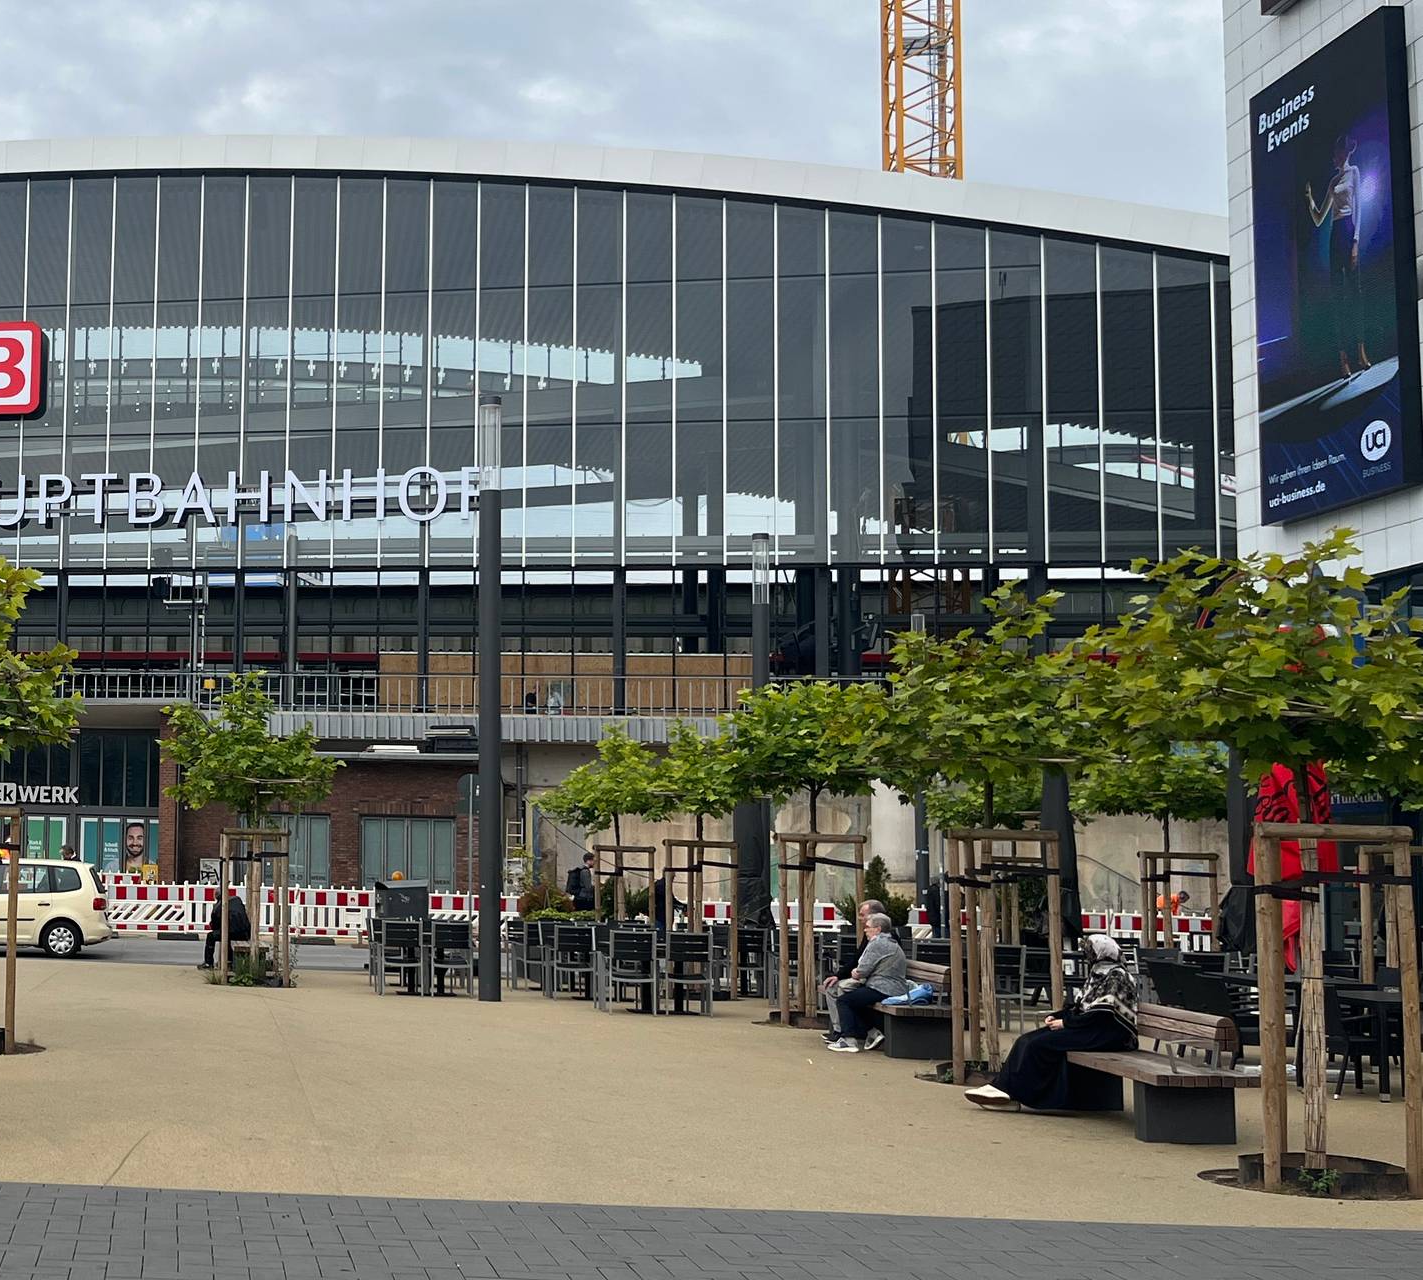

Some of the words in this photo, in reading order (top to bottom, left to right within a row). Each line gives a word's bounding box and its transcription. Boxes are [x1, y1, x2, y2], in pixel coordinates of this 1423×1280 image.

[1258, 85, 1315, 135] Business
[1267, 113, 1310, 153] Events
[1365, 428, 1386, 452] UCI
[1268, 473, 1280, 485] Wir
[1280, 468, 1296, 484] geben
[1268, 480, 1326, 508] uci-business.de
